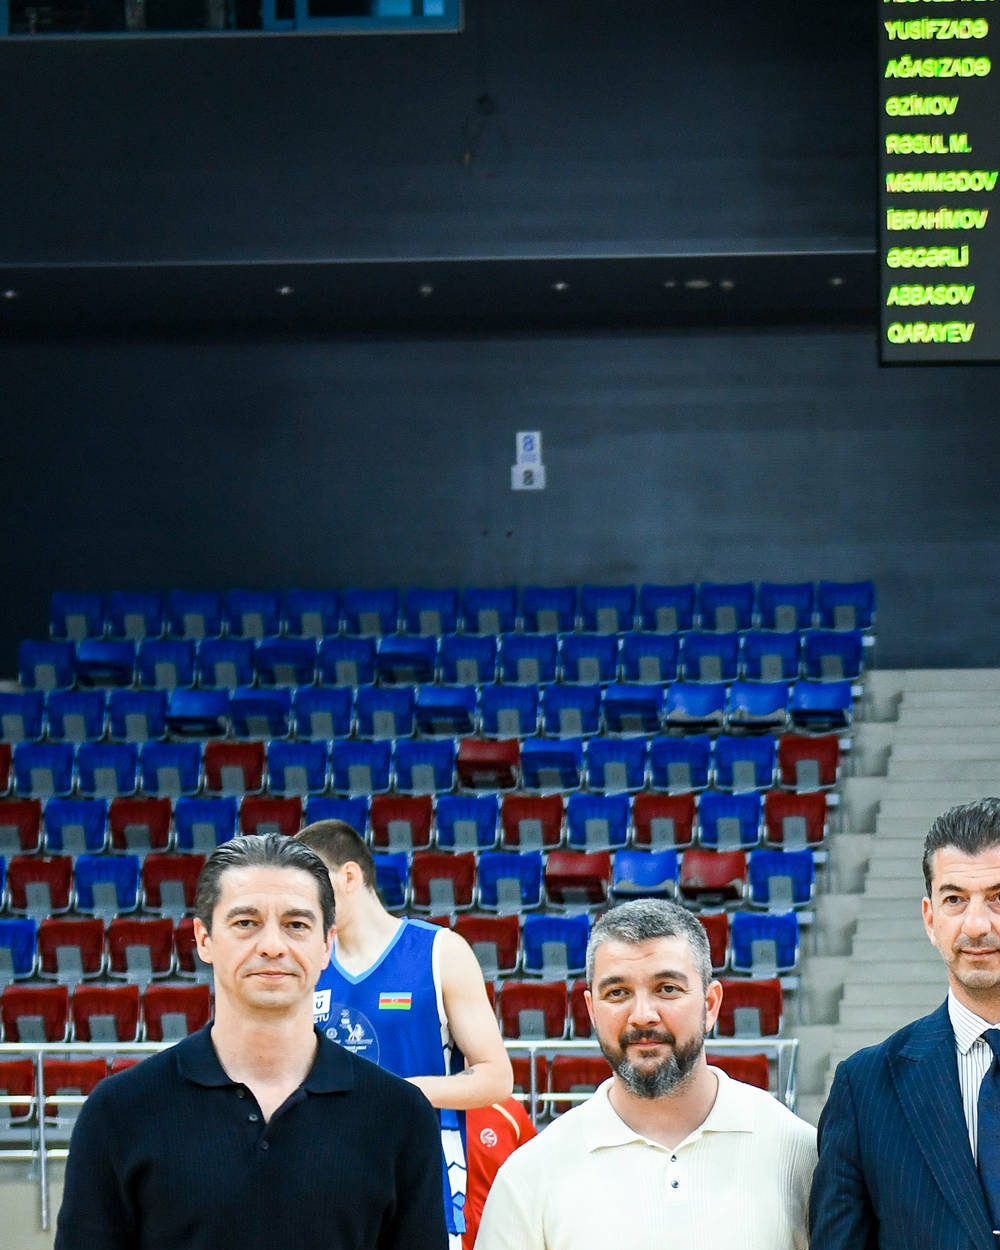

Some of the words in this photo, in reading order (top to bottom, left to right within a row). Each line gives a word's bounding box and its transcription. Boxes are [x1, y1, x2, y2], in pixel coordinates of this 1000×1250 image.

[886, 170, 998, 192] MƏMMƏDOV
[887, 284, 975, 306] ABBASOV
[887, 321, 975, 343] QARAYEV
